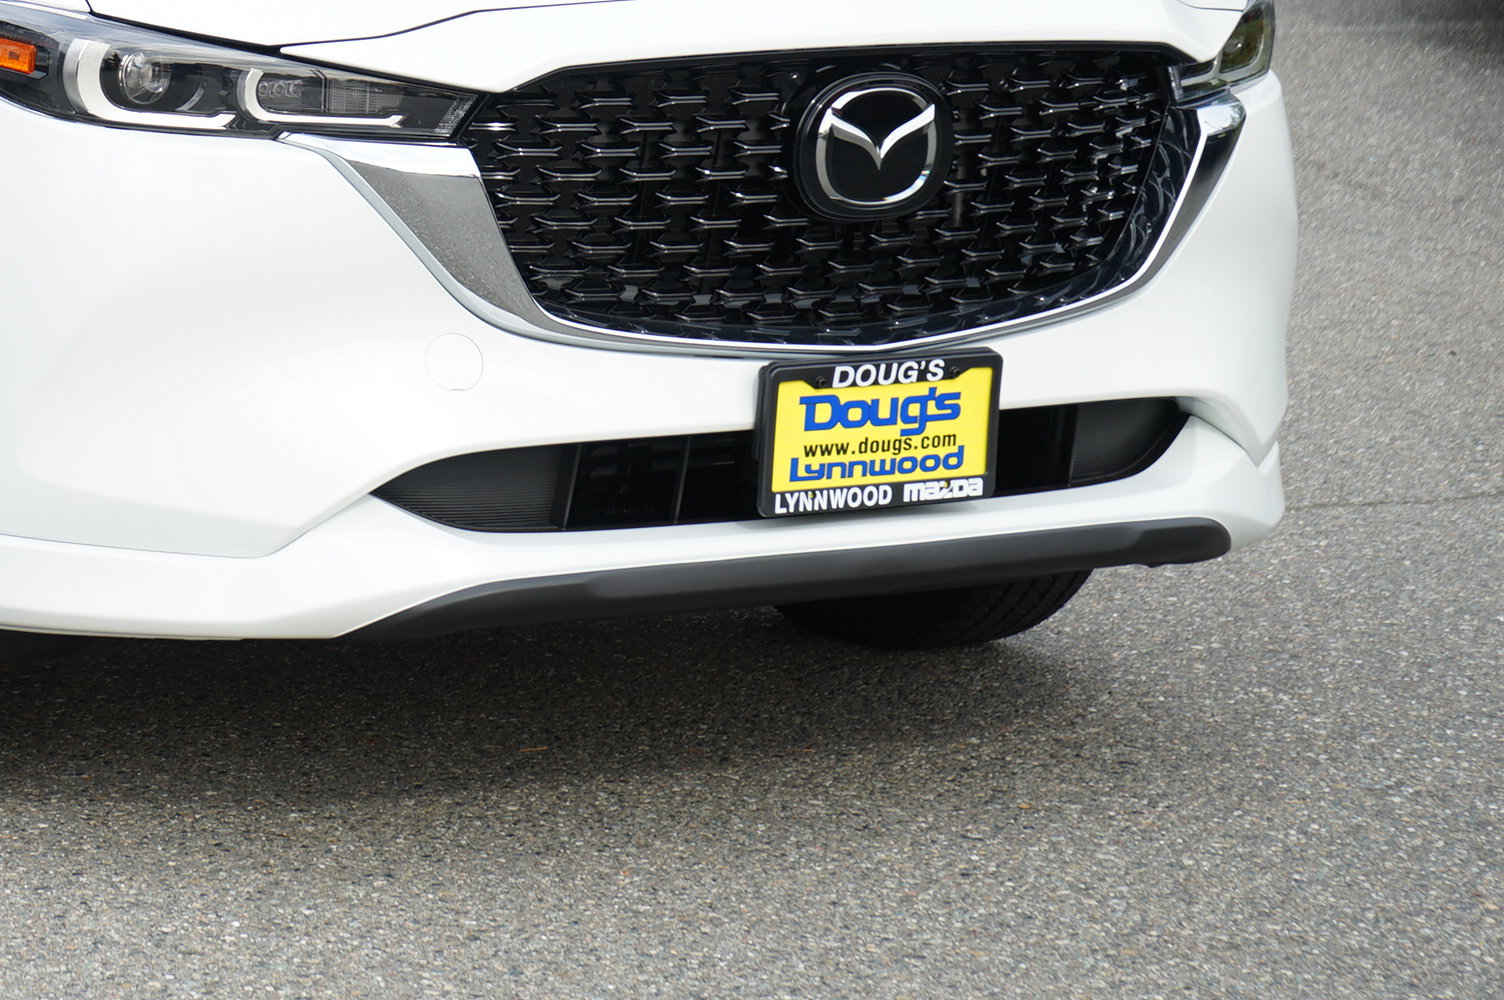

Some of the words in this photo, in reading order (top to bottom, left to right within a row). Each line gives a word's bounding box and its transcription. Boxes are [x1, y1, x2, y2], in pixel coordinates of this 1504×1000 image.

[832, 359, 945, 388] DOUG'S
[799, 386, 962, 437] Doug's
[803, 433, 958, 458] www.dougs.com
[789, 445, 965, 482] Lynnwood
[774, 485, 893, 515] LYNNWOOD
